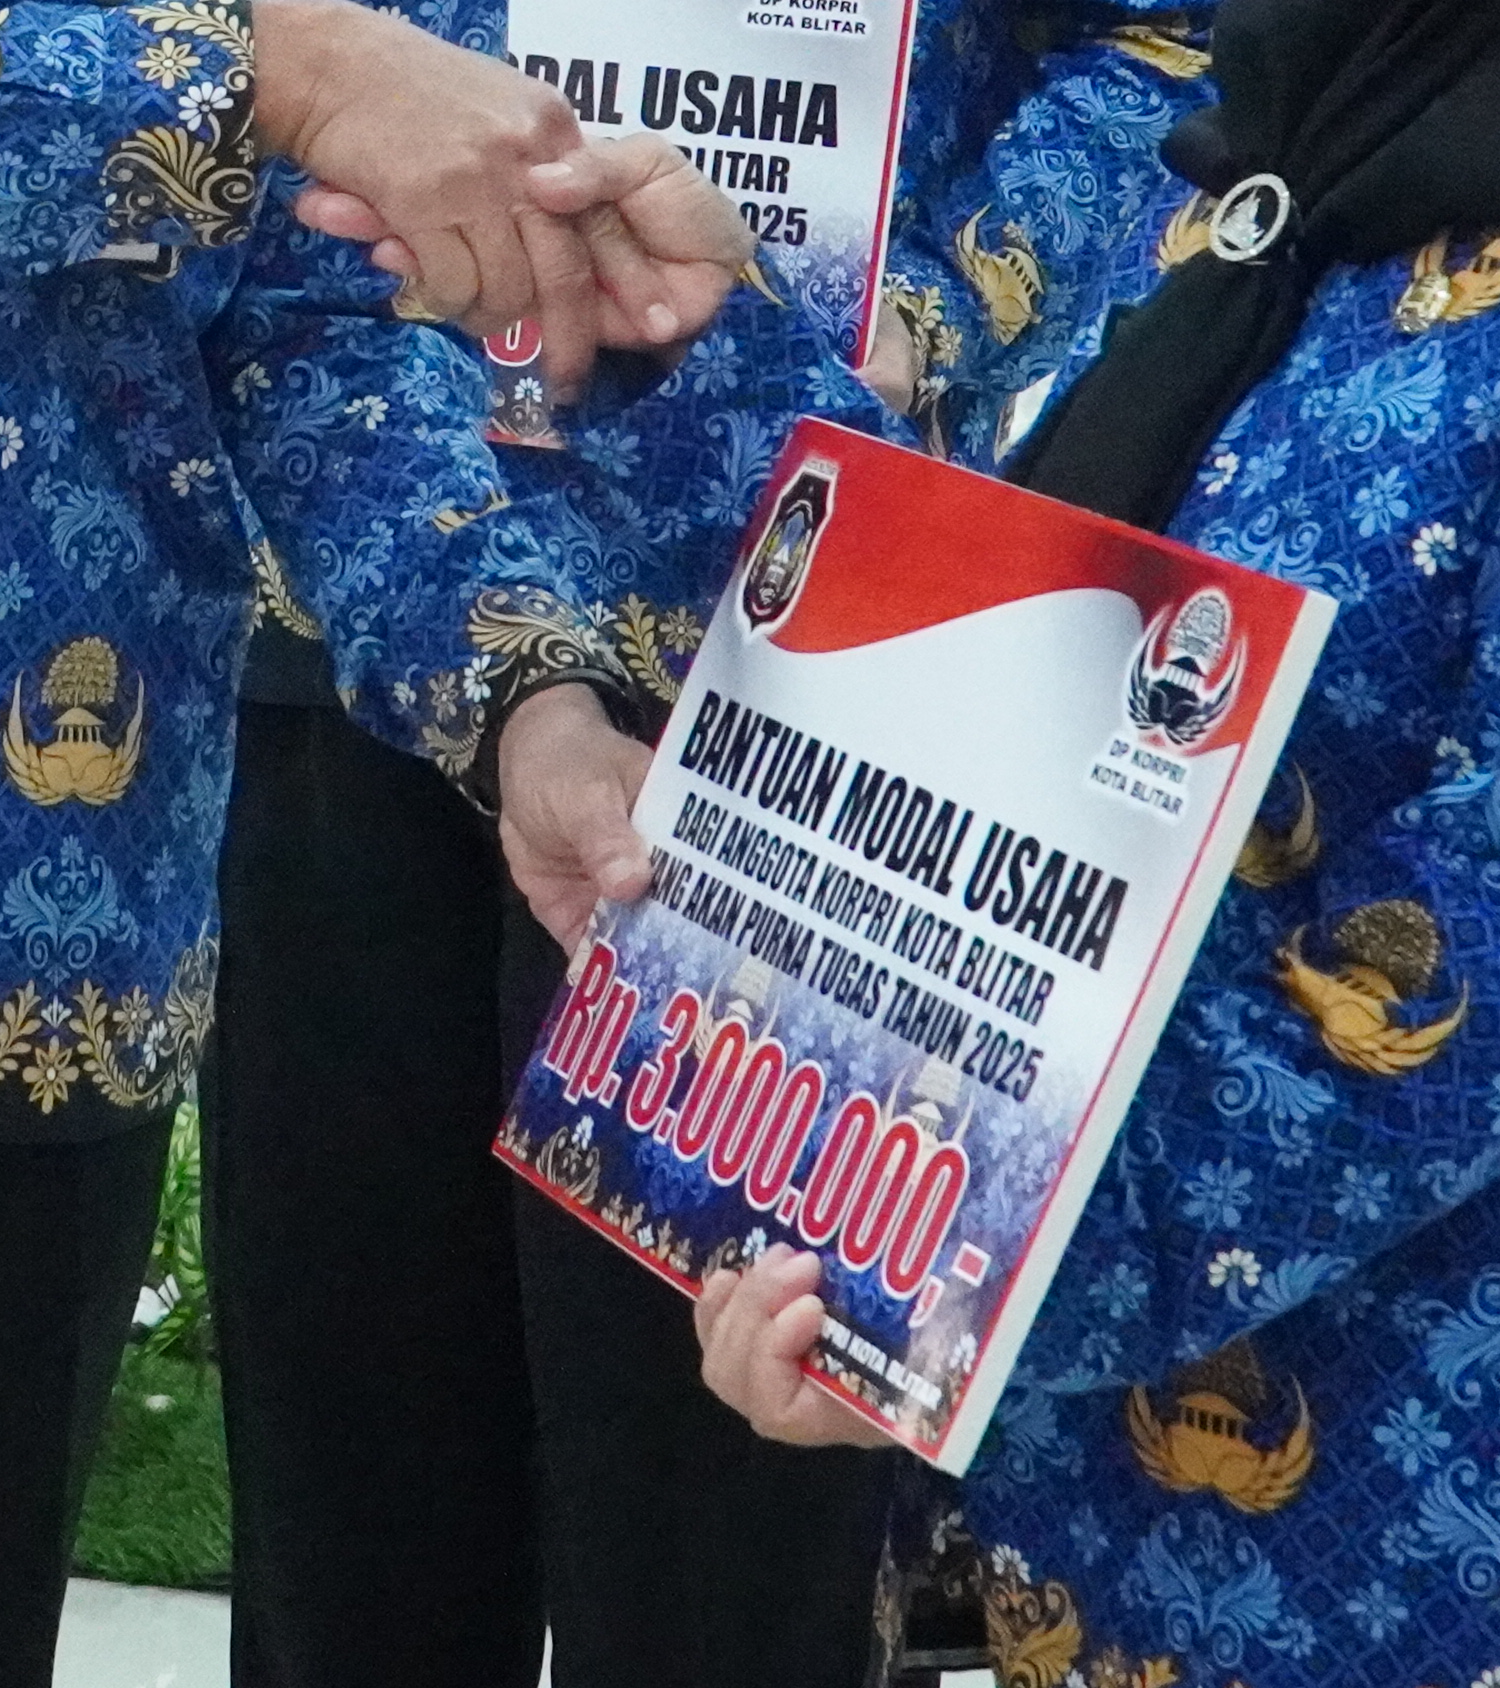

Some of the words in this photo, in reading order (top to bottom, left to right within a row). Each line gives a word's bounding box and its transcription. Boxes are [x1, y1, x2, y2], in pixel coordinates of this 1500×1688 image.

[747, 11, 794, 28] KOTA
[801, 17, 866, 34] BLITAR
[640, 65, 838, 148] USAHA
[679, 689, 848, 831] BANTUAN
[828, 760, 975, 897] MODAL
[963, 821, 1128, 972] USAHA
[1090, 763, 1128, 792] KOTA
[1130, 780, 1183, 814] BLITAR
[1131, 750, 1187, 784] KORPRI
[649, 845, 693, 911] YANG
[682, 872, 747, 941] AKAN
[736, 900, 815, 980] PURNA
[808, 937, 889, 1019] TUGAS
[882, 975, 972, 1064] TAHUN
[961, 1021, 1044, 1102] 2025
[673, 792, 728, 856] BAGI
[717, 816, 818, 904] ANGGOTA
[810, 862, 903, 946] KORPRI
[892, 904, 963, 980] KOTA
[956, 935, 1055, 1026] BLITAR
[543, 937, 641, 1109] Rp.
[625, 987, 991, 1327] 3.000.000,-
